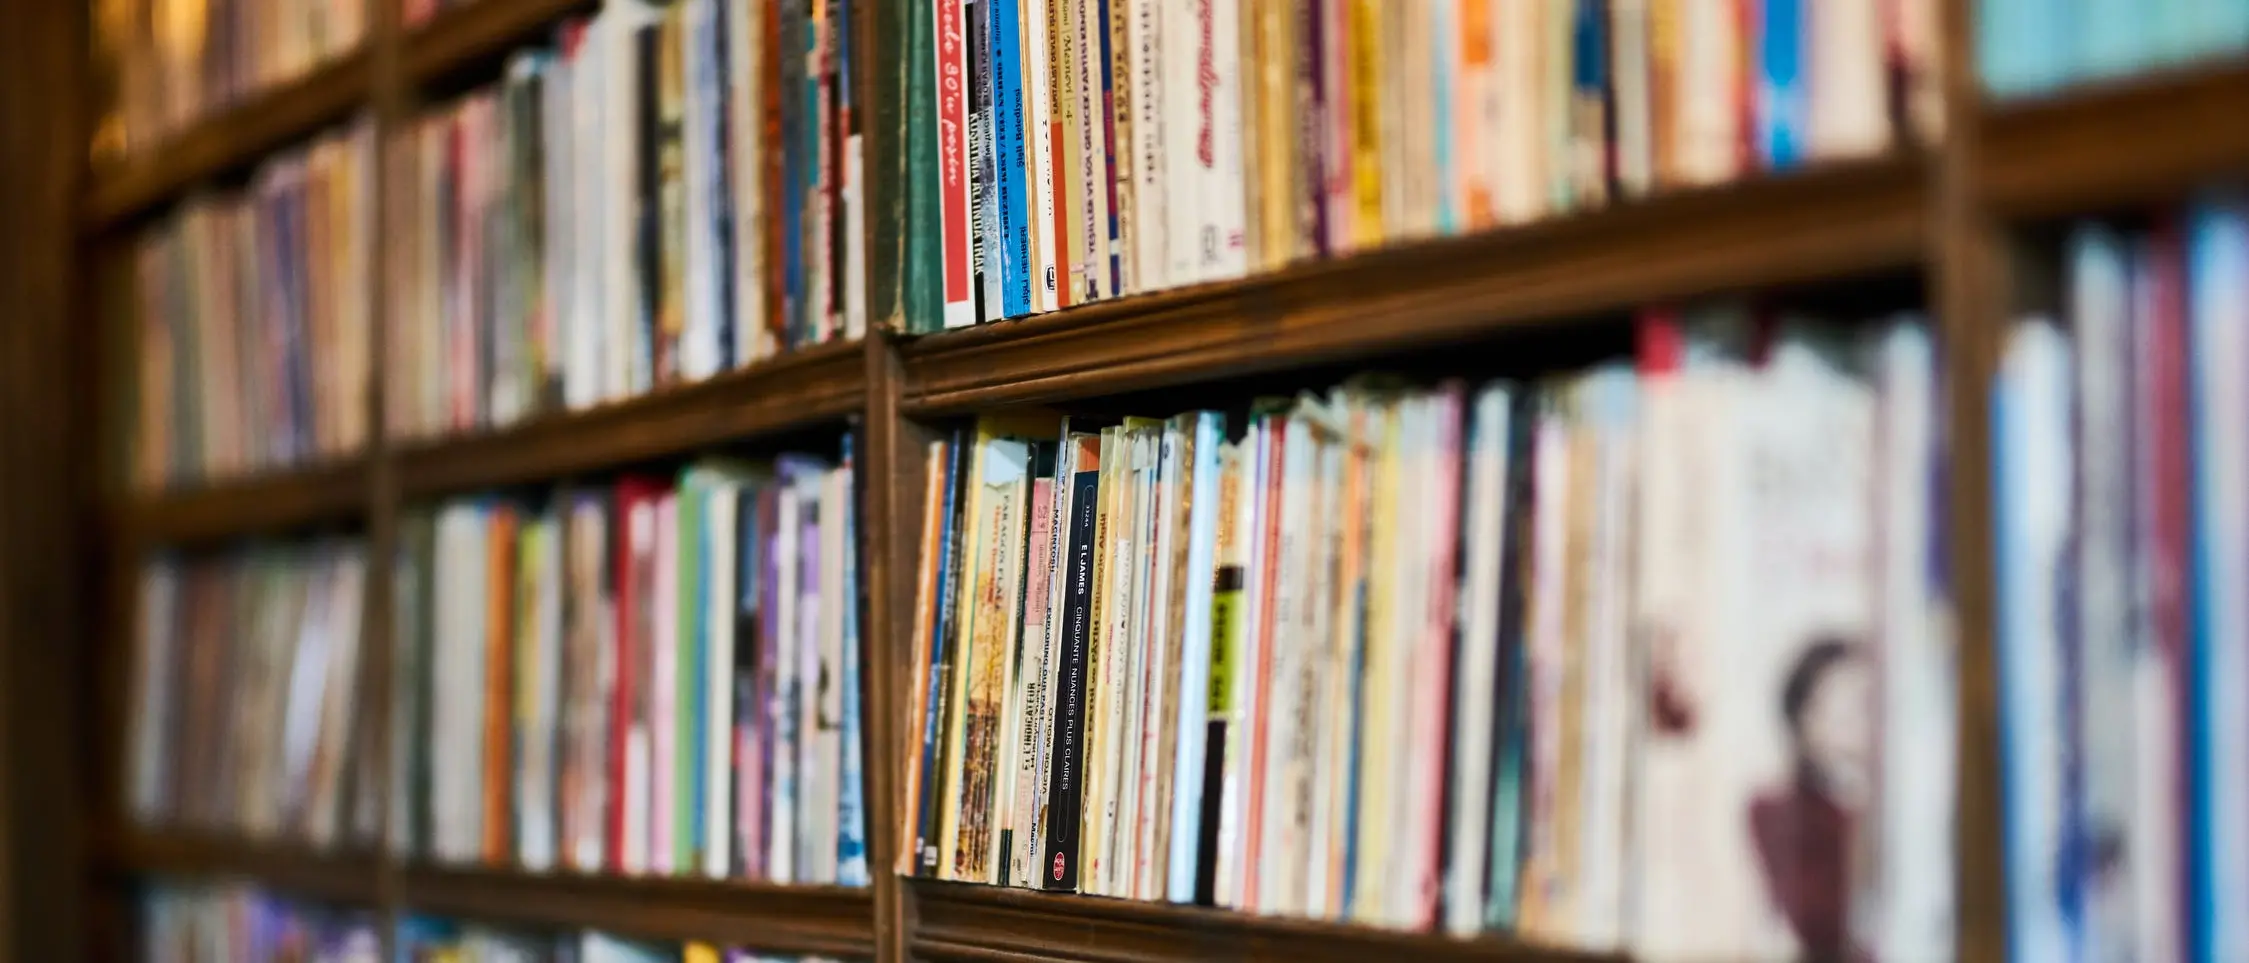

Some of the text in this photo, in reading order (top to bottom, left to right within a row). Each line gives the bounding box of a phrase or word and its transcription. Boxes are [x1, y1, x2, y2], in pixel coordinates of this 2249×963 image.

[1012, 88, 1023, 141] Belediyesi
[1085, 154, 1093, 177] SOL
[1019, 226, 1028, 274] REHBERİ
[1050, 509, 1060, 573] MACINTOSH
[1077, 558, 1087, 595] JAMES
[1042, 607, 1052, 665] EXPLORING
[1062, 606, 1083, 791] CINQUANTE NUANCES PLUS CLAIRES
[1042, 752, 1051, 794] VICTOR
